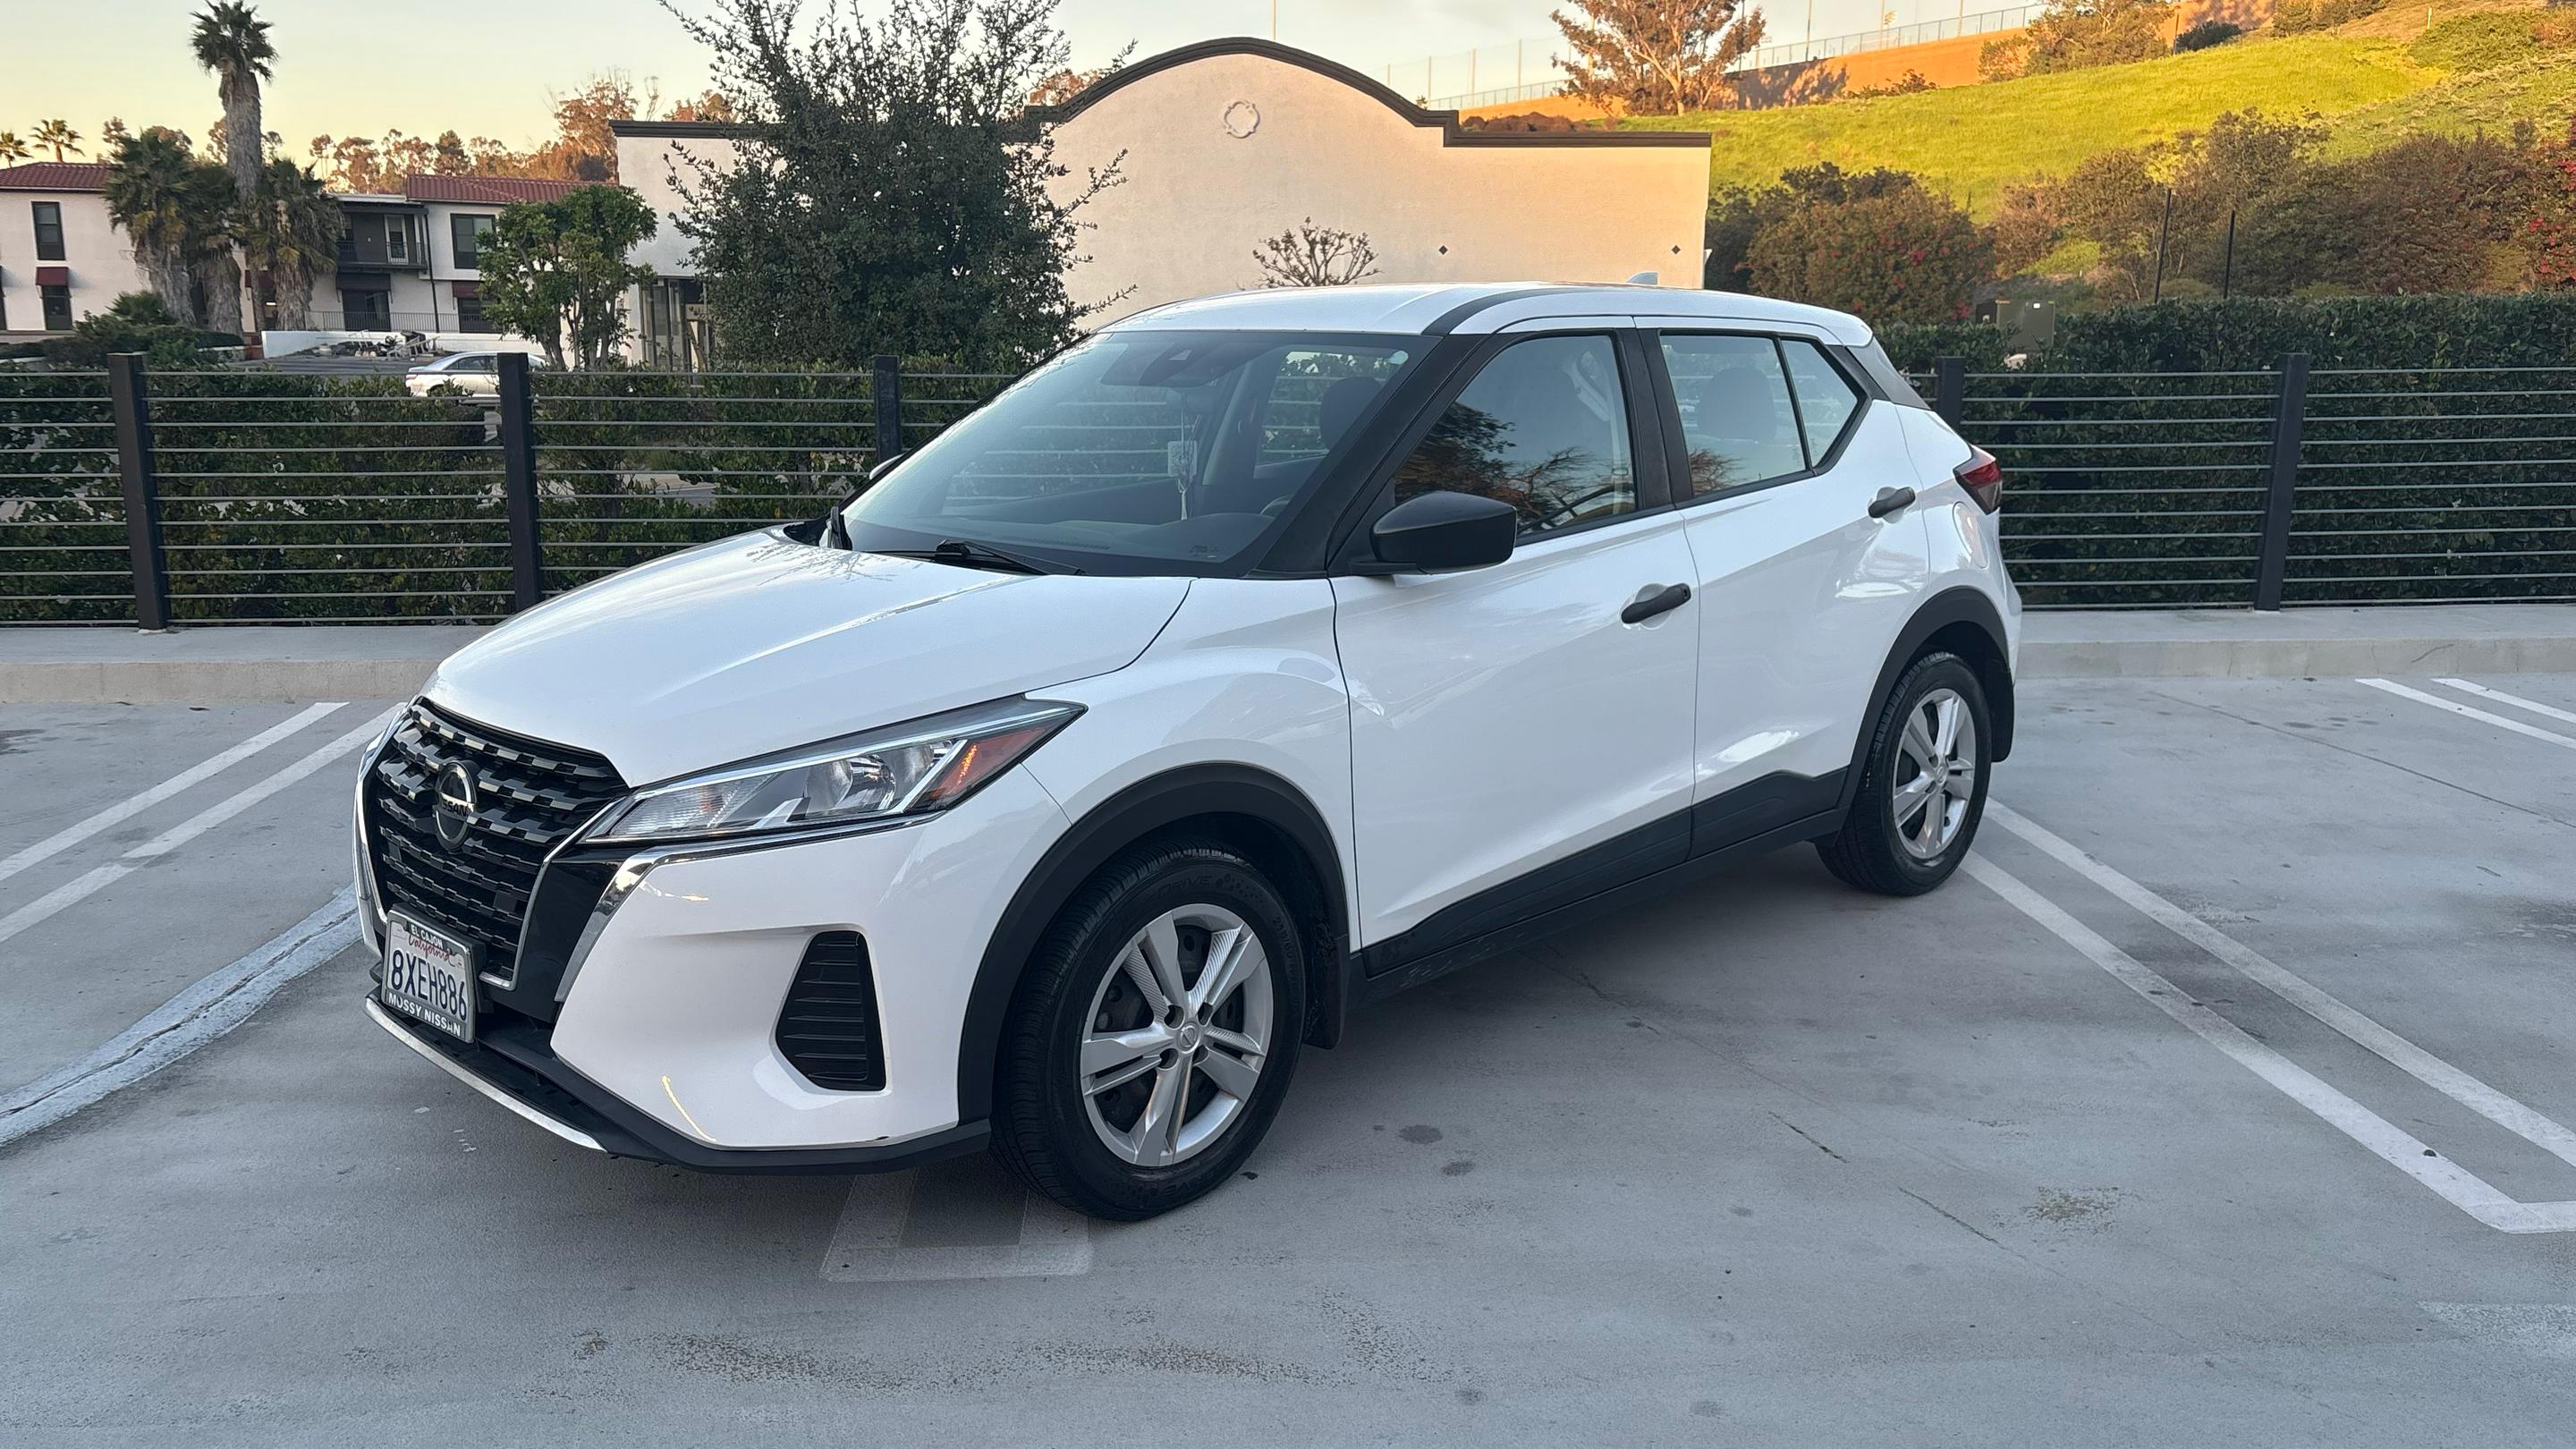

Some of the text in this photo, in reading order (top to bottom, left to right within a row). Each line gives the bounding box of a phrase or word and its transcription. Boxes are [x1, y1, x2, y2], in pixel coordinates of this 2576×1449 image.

[411, 925, 444, 948] EL CAJON
[391, 949, 467, 1021] 8XEH886
[388, 992, 461, 1037] MOSSY NISSAN
